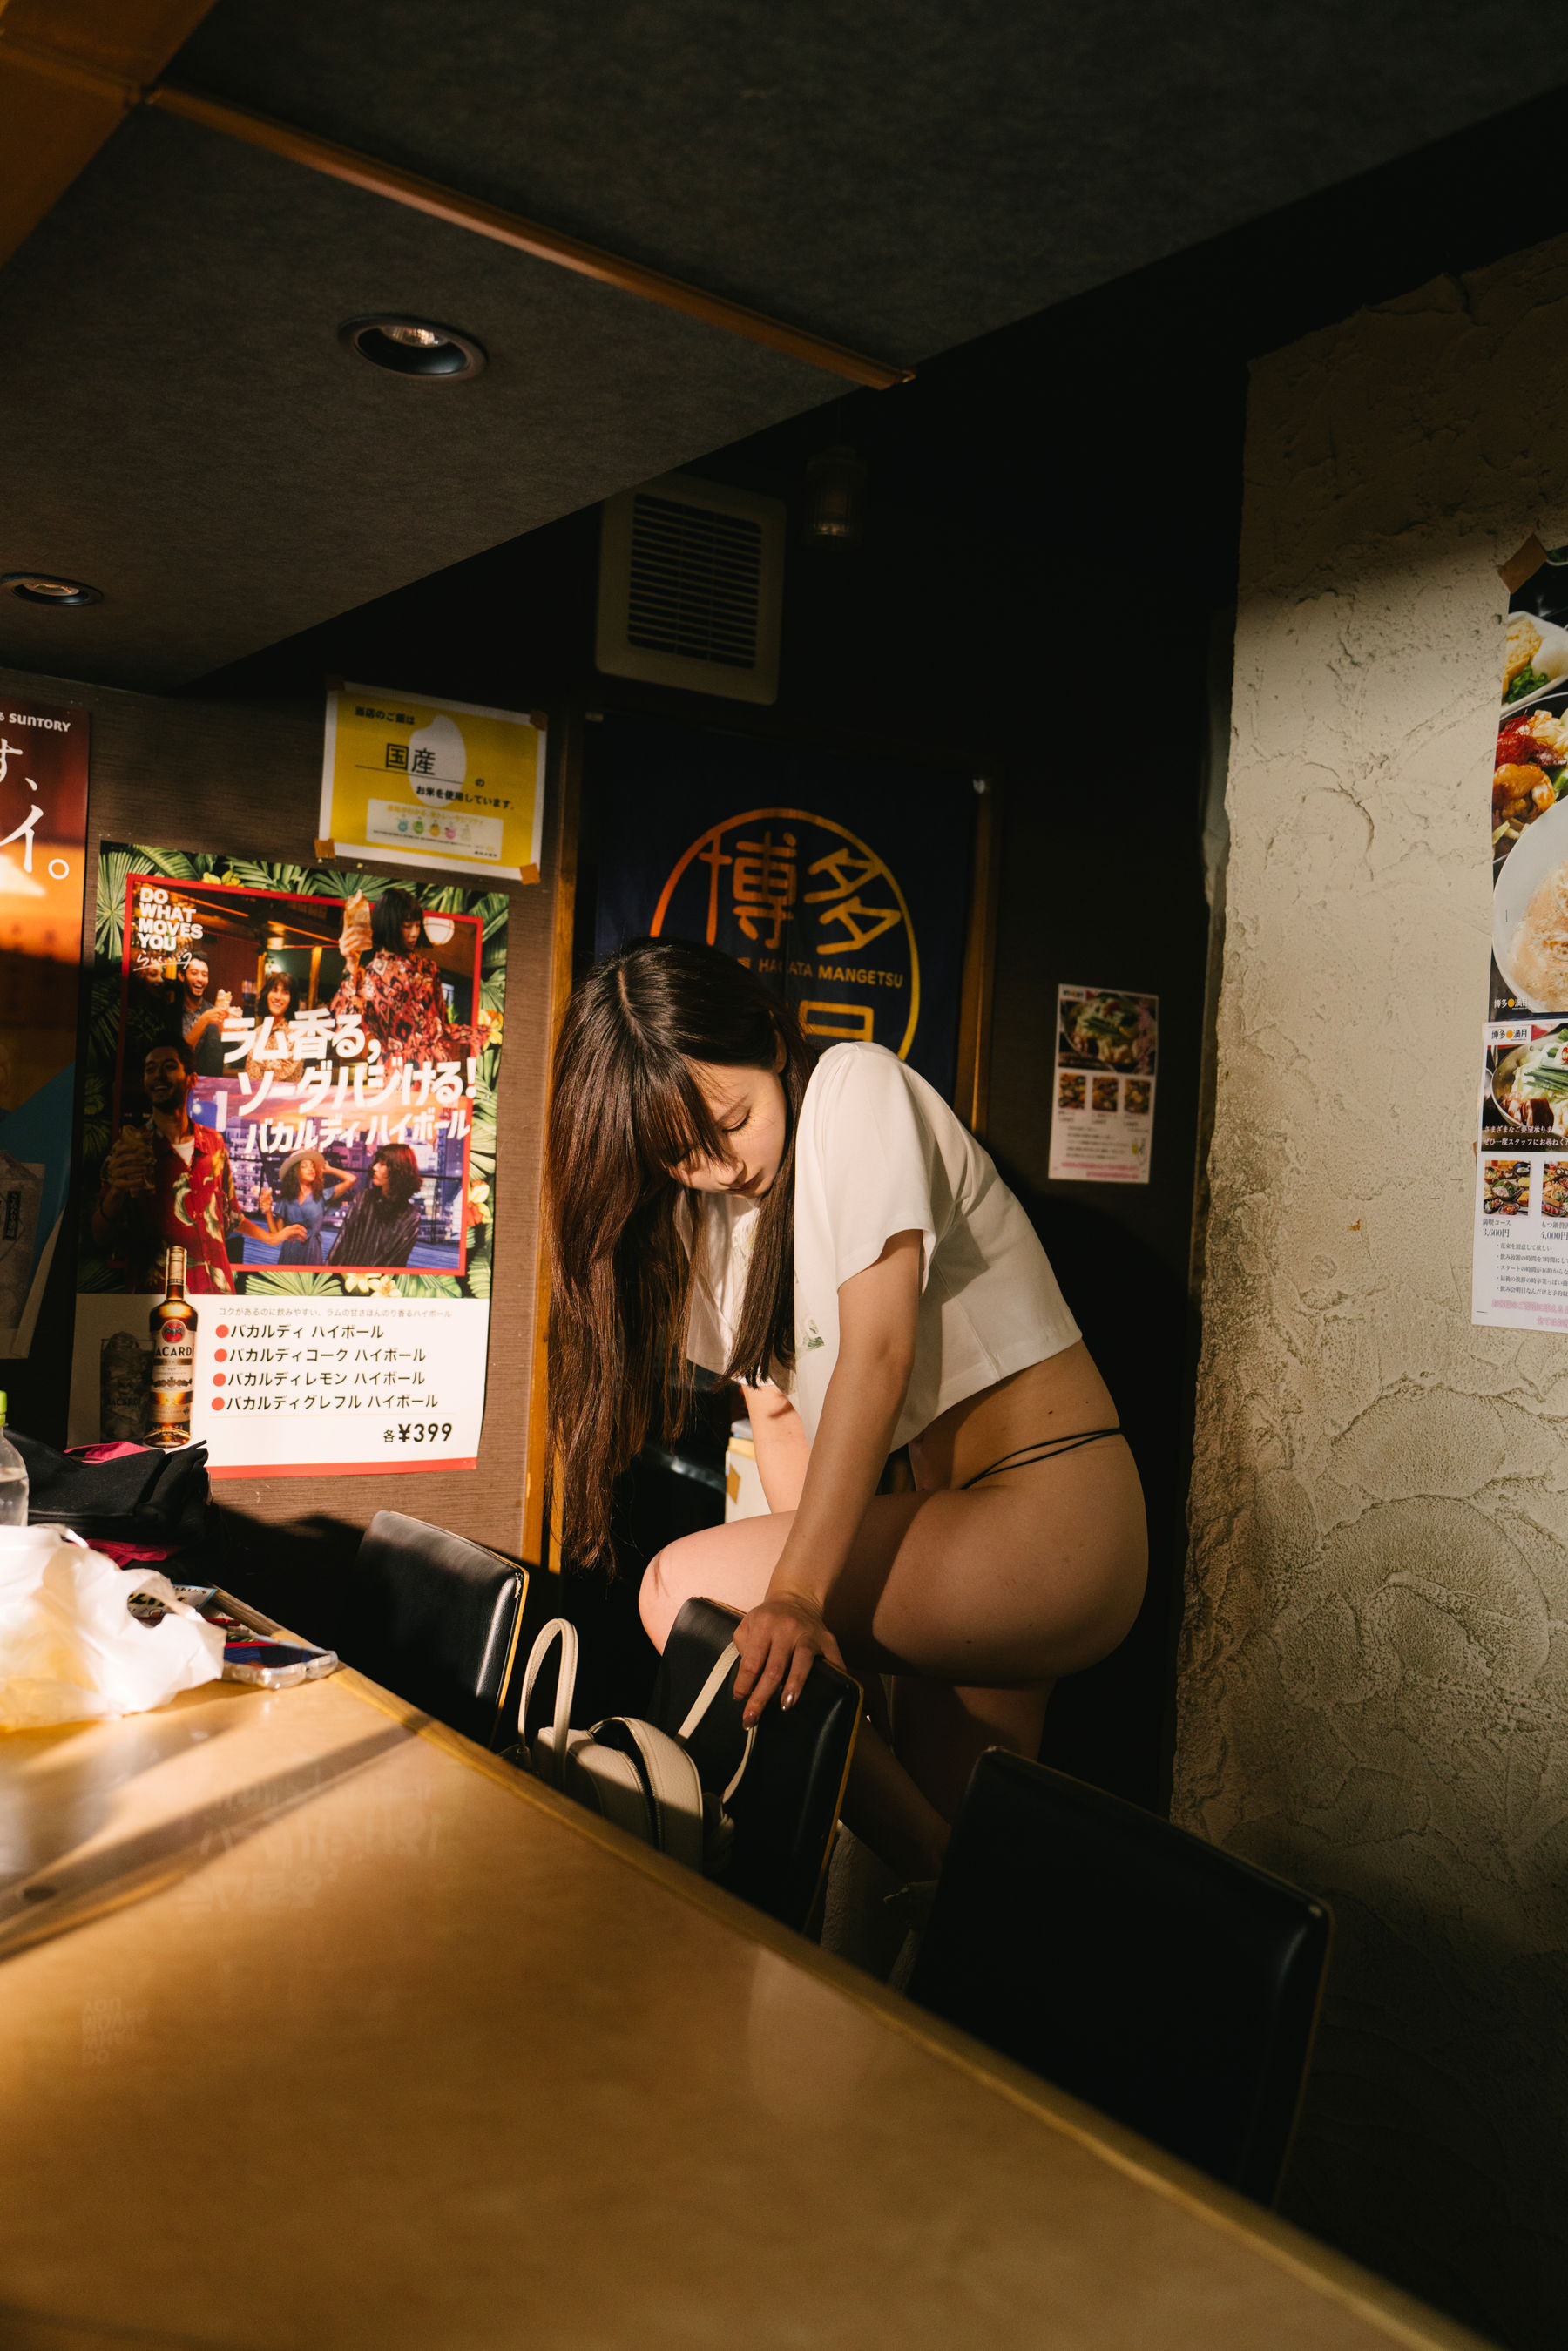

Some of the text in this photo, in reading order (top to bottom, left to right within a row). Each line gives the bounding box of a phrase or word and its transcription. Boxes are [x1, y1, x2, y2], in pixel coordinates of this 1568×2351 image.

[385, 742, 436, 776] 国産
[475, 778, 485, 788] の
[139, 887, 169, 905] DO
[698, 830, 902, 956] 博多
[139, 902, 197, 923] WHAT
[137, 918, 204, 941] MOVES
[137, 933, 177, 952] YOU
[758, 957, 904, 989] HAATA MANGETSU
[230, 1323, 384, 1340] バカルディ ハイボール
[228, 1348, 426, 1363] バカルディコーク ハイボール
[227, 1371, 425, 1387] バカルディレモン ハイボール
[226, 1394, 439, 1411] バカルディグレフル ハイボール
